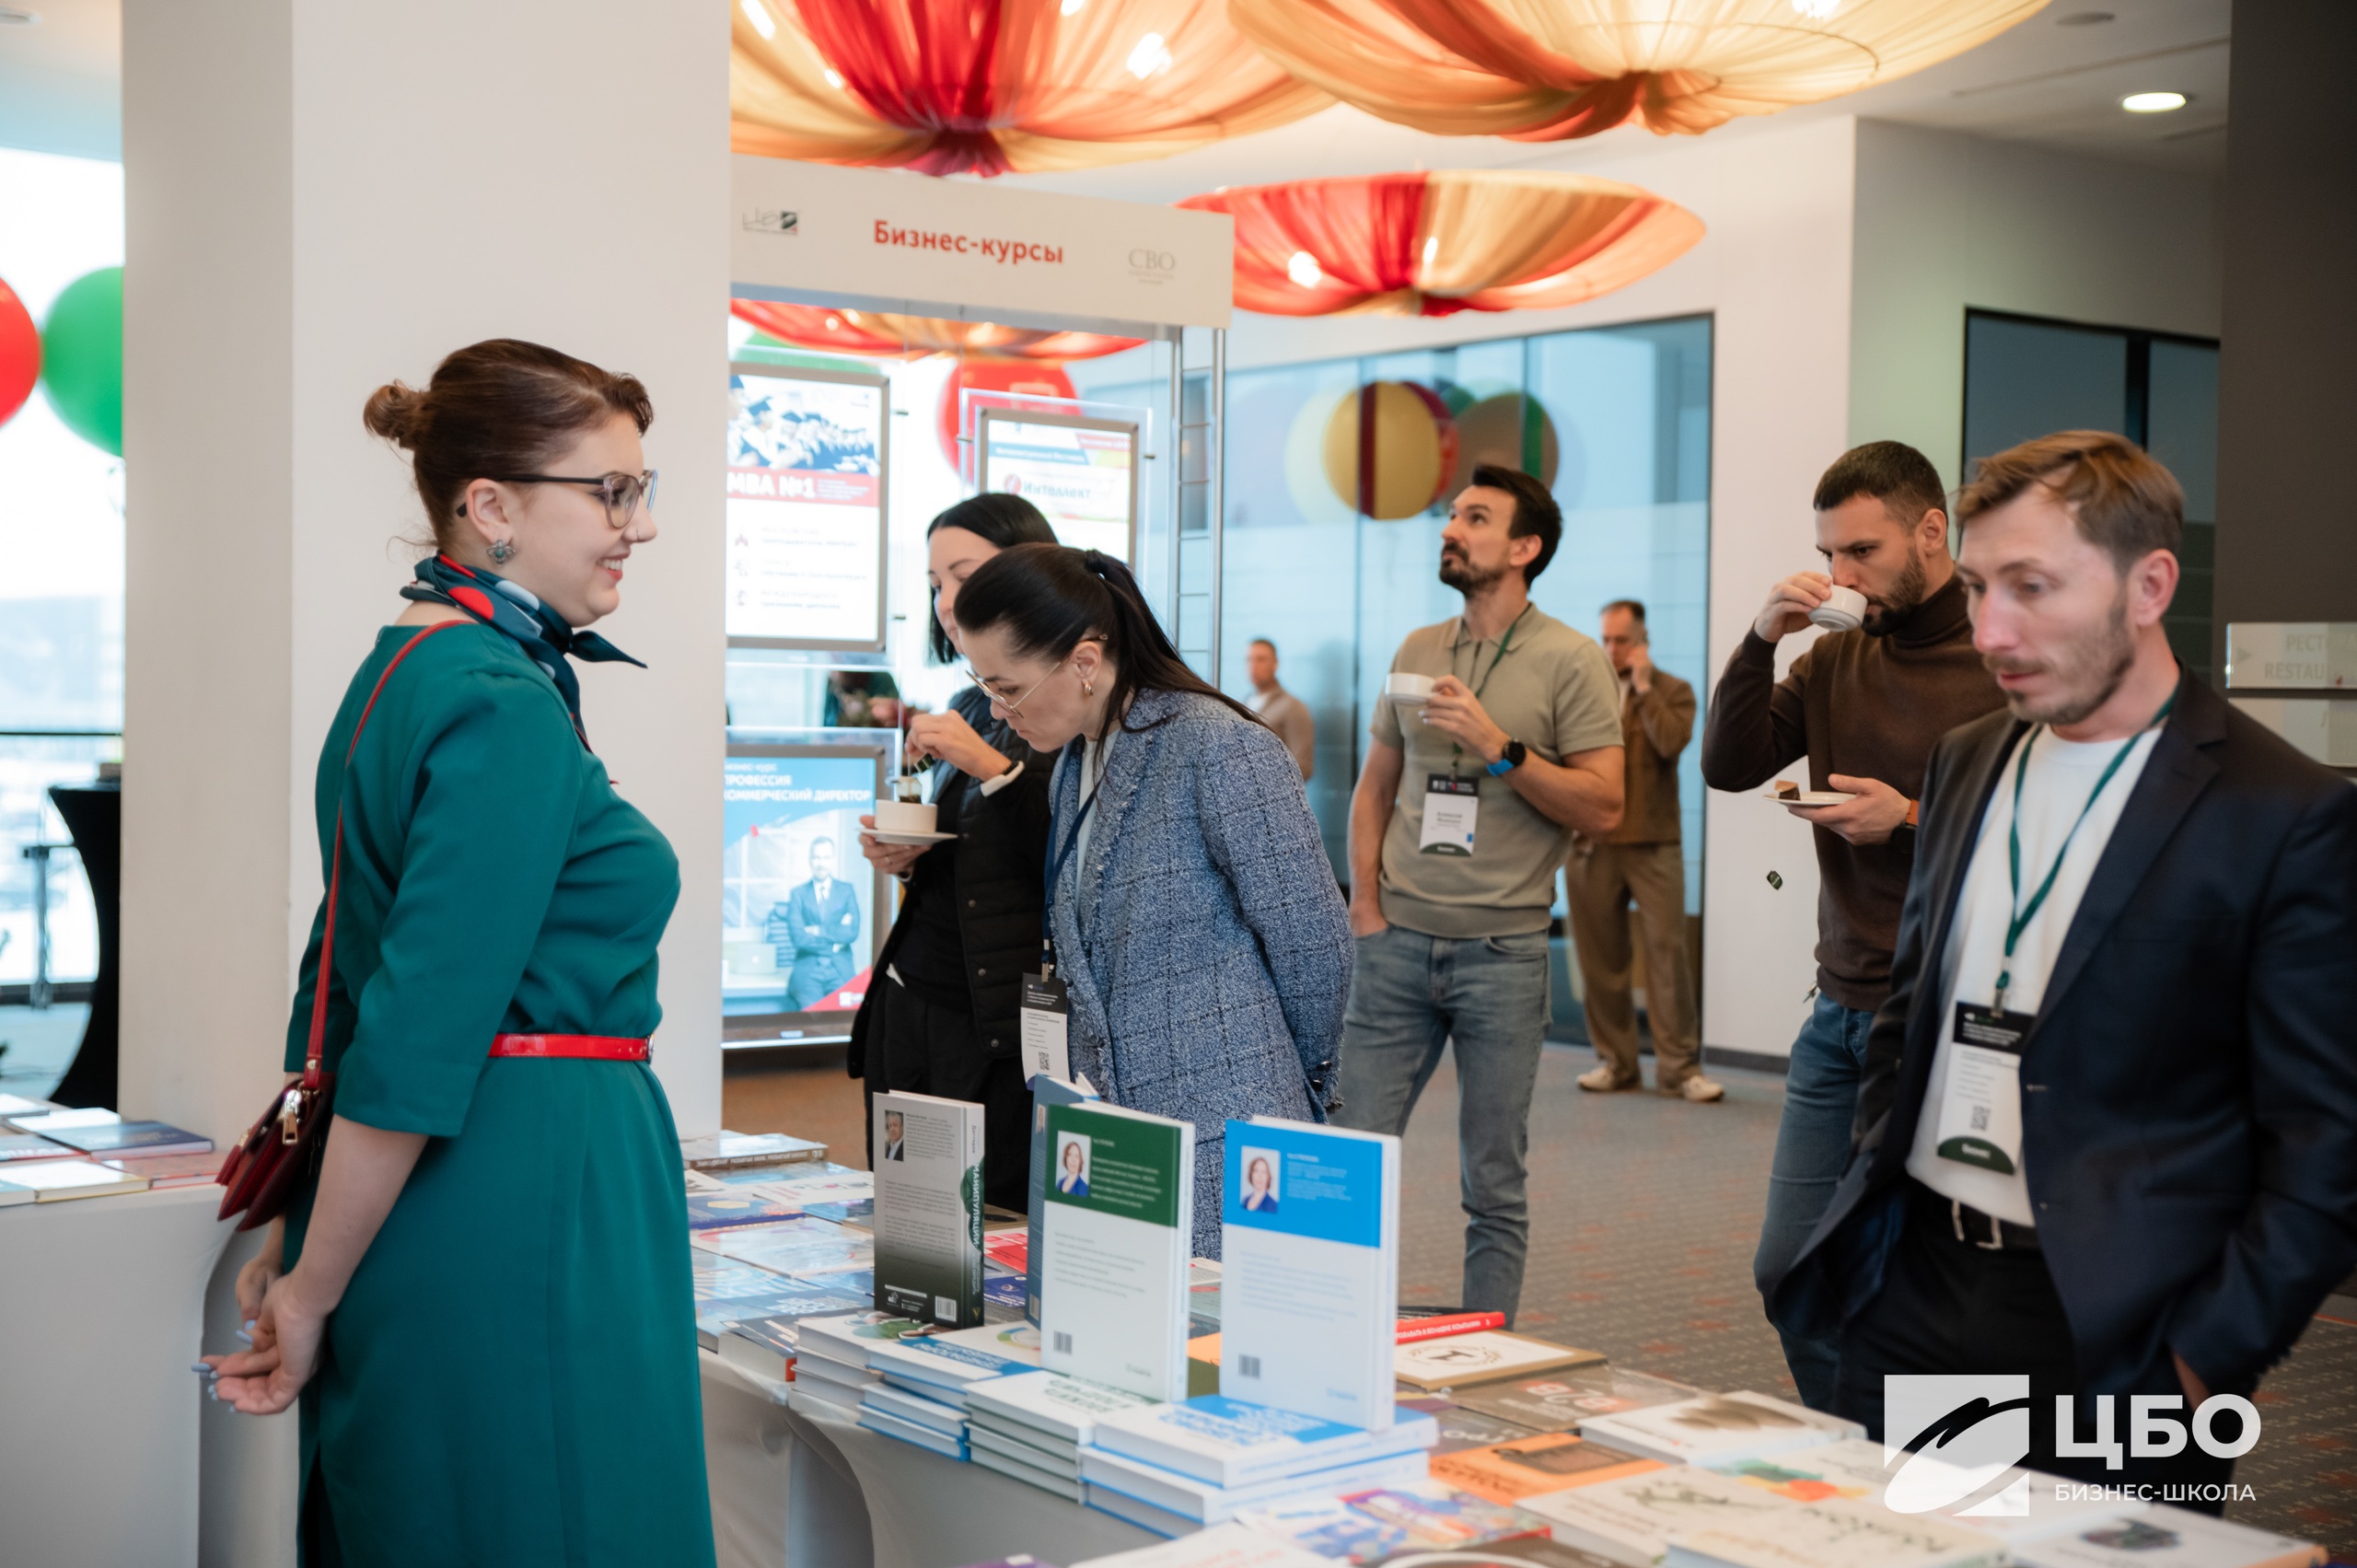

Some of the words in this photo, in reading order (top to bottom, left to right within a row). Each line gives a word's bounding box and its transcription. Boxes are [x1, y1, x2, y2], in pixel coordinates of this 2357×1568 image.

[874, 219, 1062, 264] Бизнес-курсы
[1128, 248, 1176, 271] CBO
[1024, 481, 1090, 498] Интеллект
[726, 762, 777, 772] изнес-курс
[813, 790, 870, 803] ДИРЕКТОР
[1395, 1329, 1422, 1339] РОДАВАТЬ
